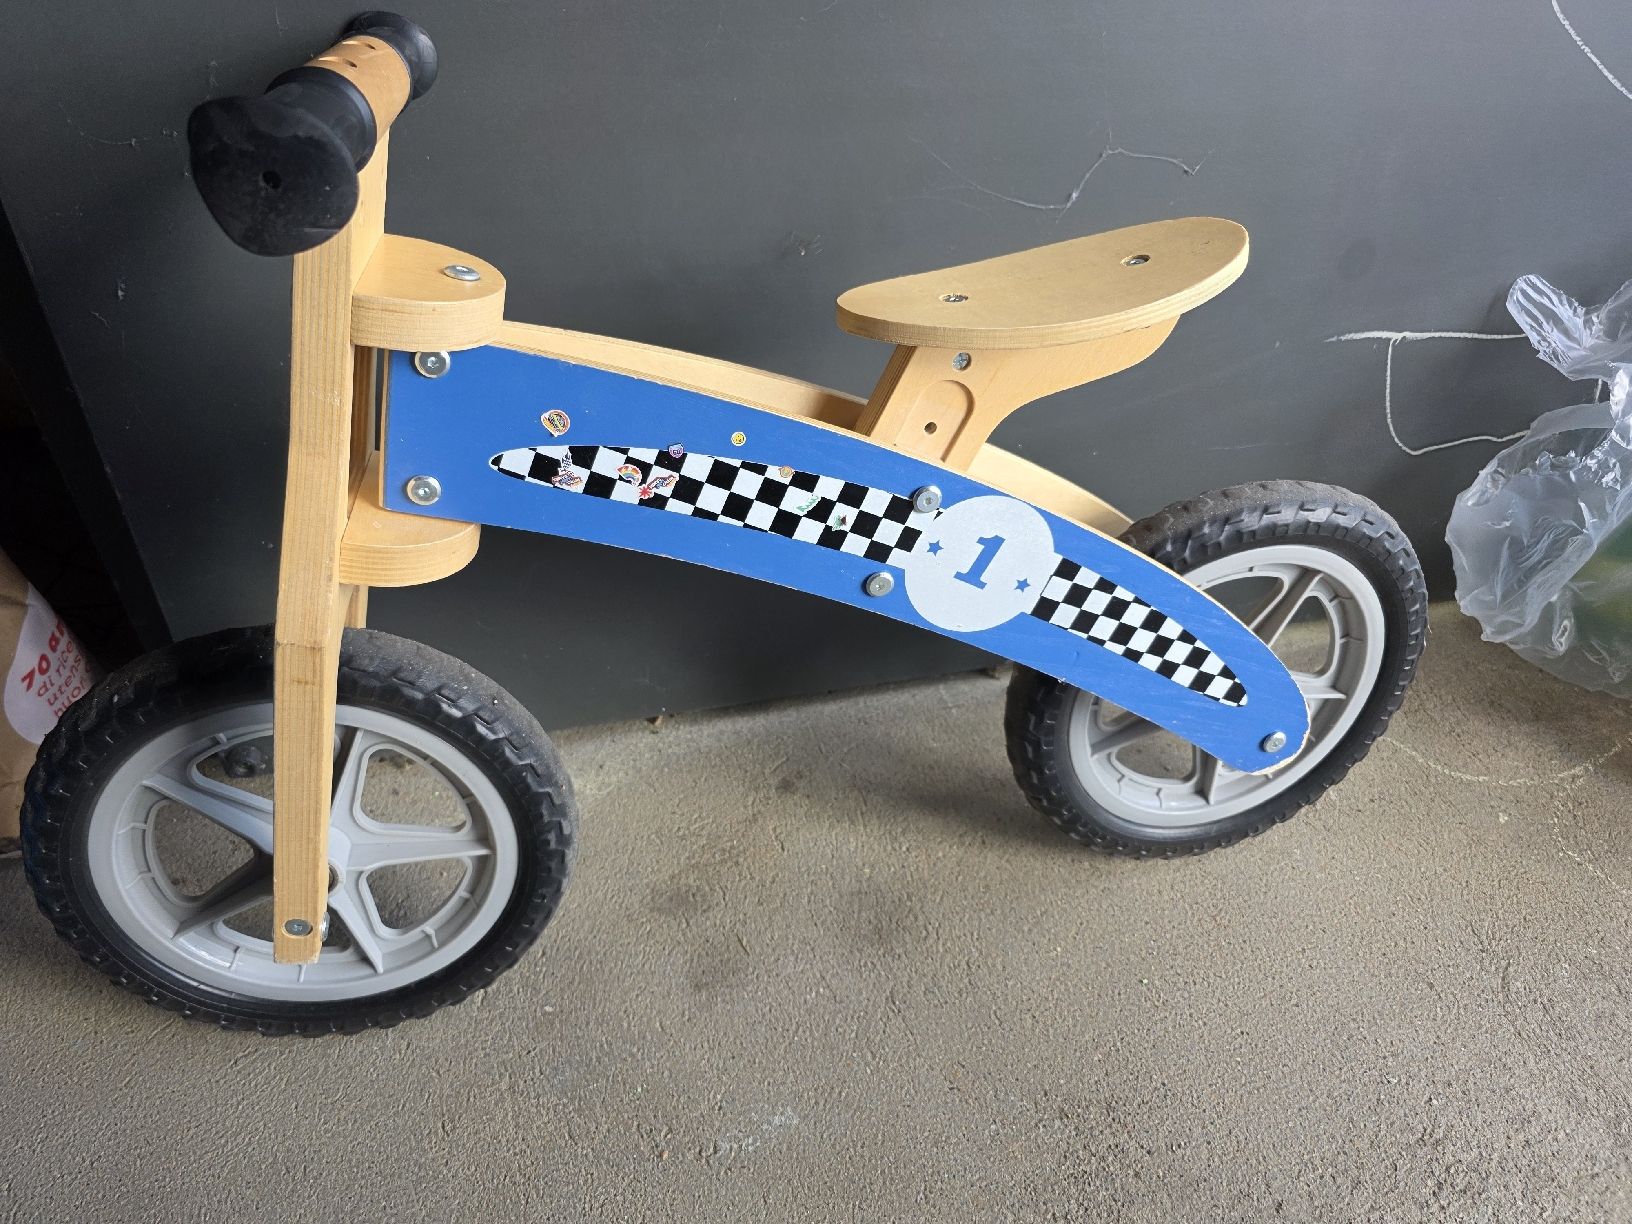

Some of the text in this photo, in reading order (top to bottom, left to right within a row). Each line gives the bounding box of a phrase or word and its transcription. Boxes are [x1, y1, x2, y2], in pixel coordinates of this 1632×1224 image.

[953, 534, 1006, 590] 1
[21, 653, 51, 692] 70
[38, 676, 55, 697] di
